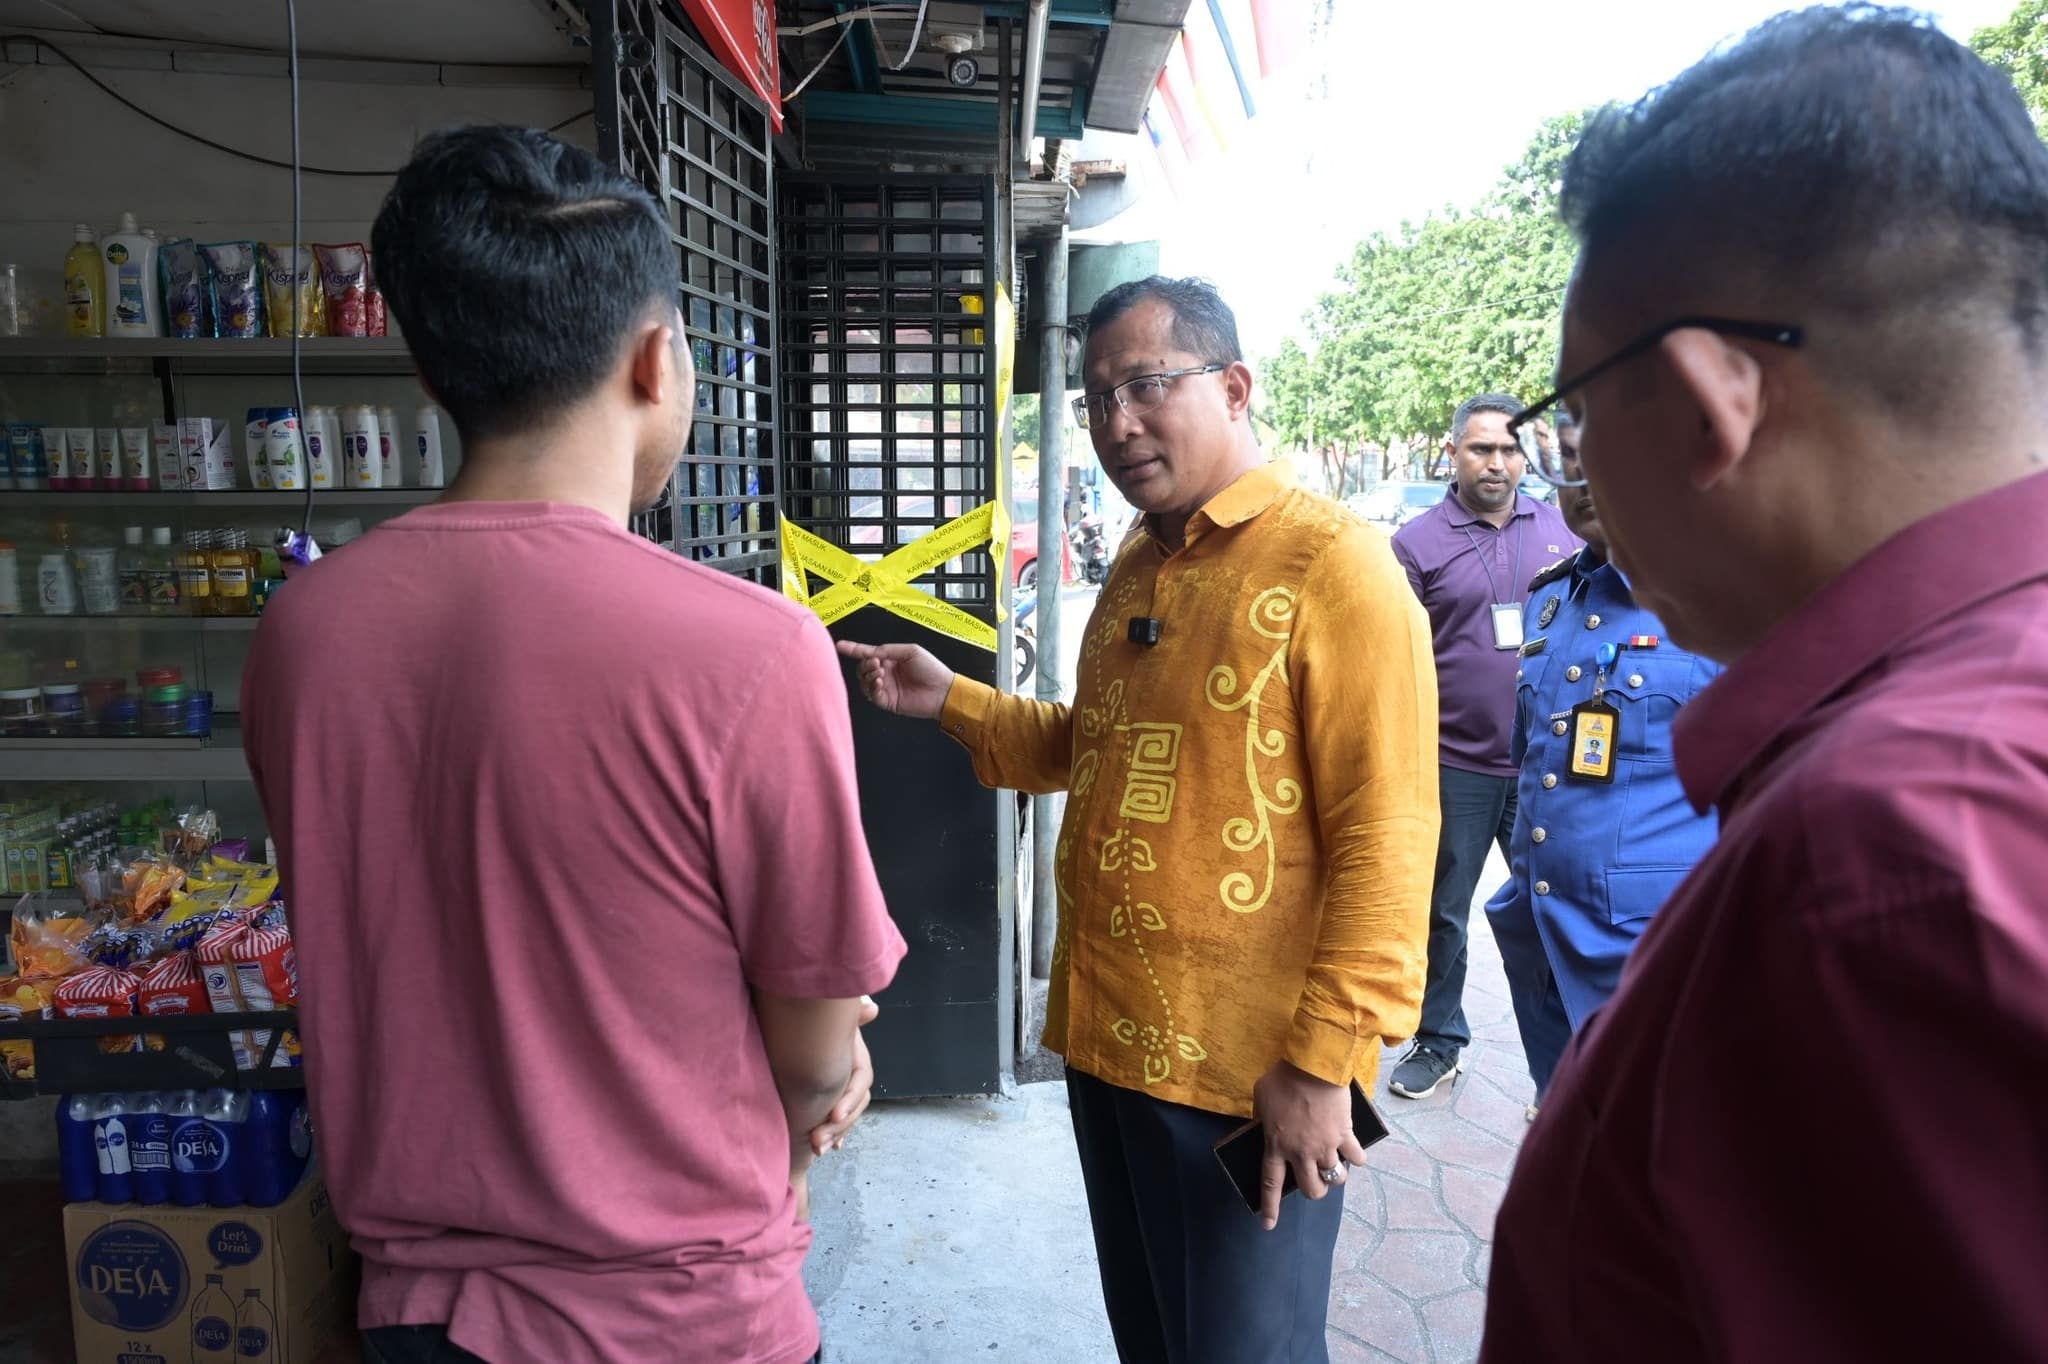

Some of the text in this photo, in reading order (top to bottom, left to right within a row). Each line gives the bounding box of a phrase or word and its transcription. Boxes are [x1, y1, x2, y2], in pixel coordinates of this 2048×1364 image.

[926, 509, 989, 544] DI LARANG MASUK
[801, 532, 827, 552] MASUK
[907, 553, 940, 575] KAWALAN
[940, 526, 991, 557] PENGUATKUAS
[808, 595, 827, 608] ASUK
[890, 601, 925, 622] KAWALAN
[963, 617, 990, 634] MASUK
[178, 1140, 220, 1158] DESA
[221, 1228, 248, 1241] Let's
[217, 1241, 251, 1255] Drink
[90, 1264, 173, 1300] DESA
[199, 1328, 226, 1342] DESA
[127, 1341, 141, 1353] 12
